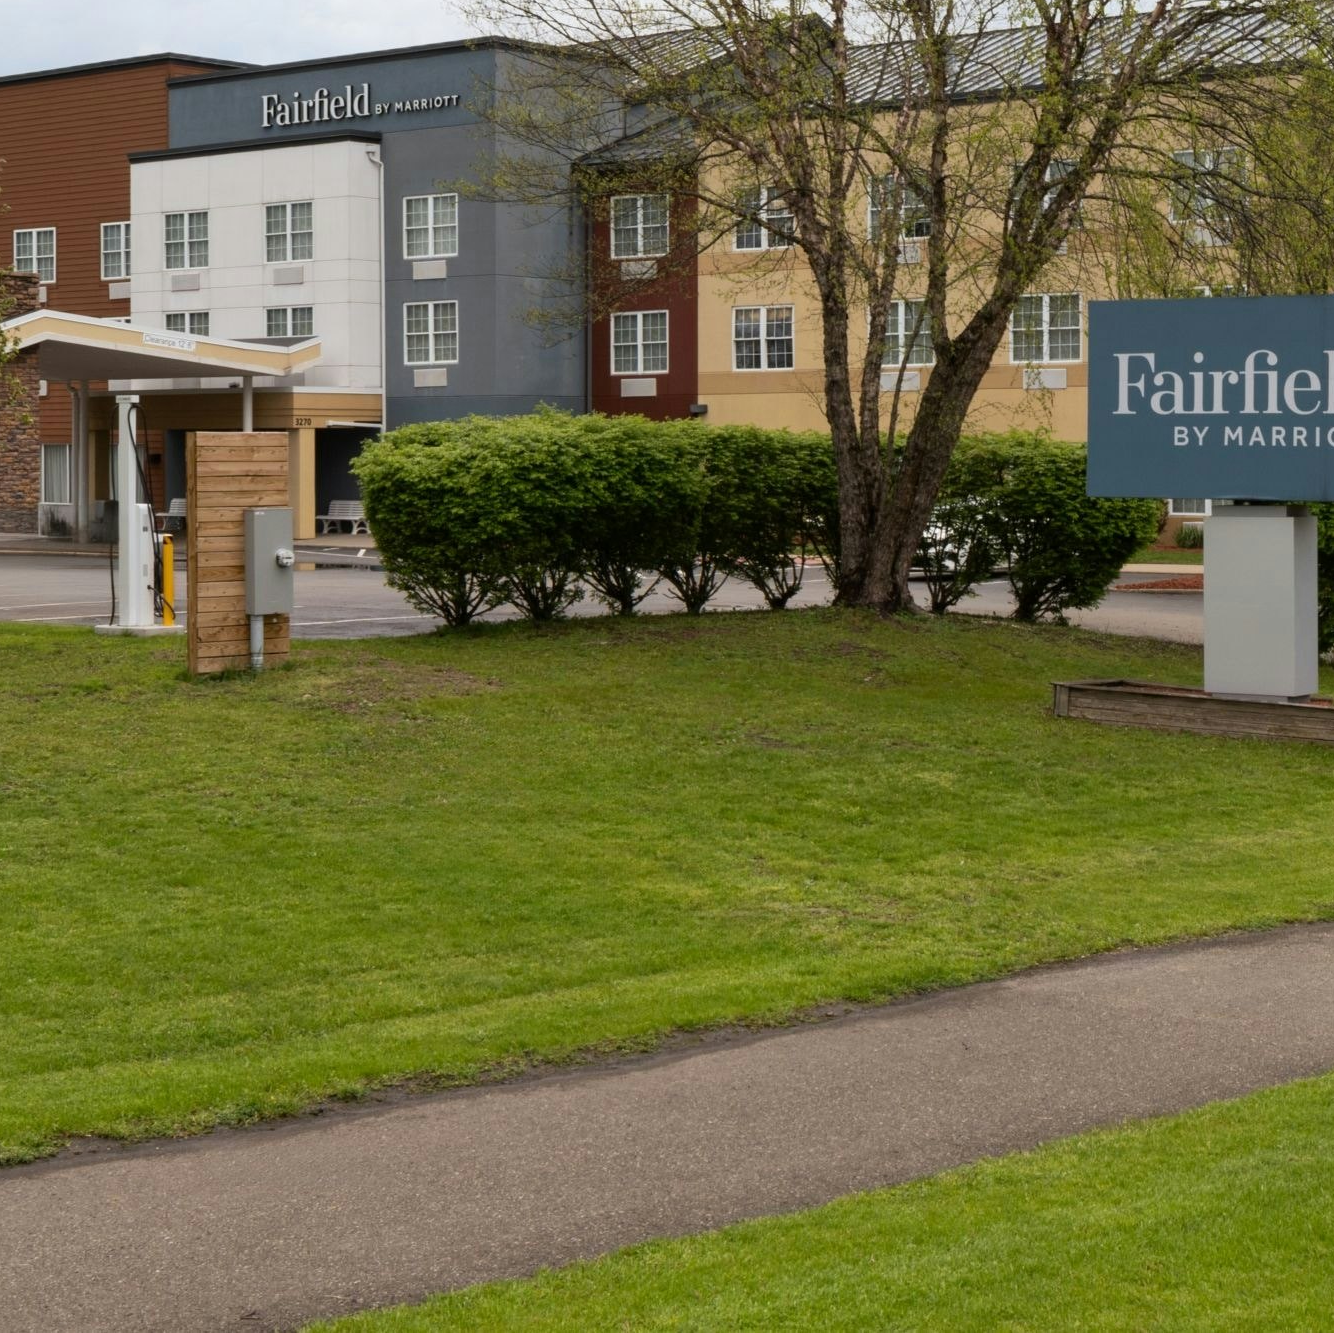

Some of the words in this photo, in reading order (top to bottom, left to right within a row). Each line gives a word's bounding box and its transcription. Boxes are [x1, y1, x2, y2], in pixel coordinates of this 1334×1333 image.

[261, 82, 371, 127] Fairfield
[375, 102, 390, 115] BY
[394, 94, 459, 113] MARRIOTT
[294, 417, 312, 426] 3270
[1173, 425, 1210, 447] BY
